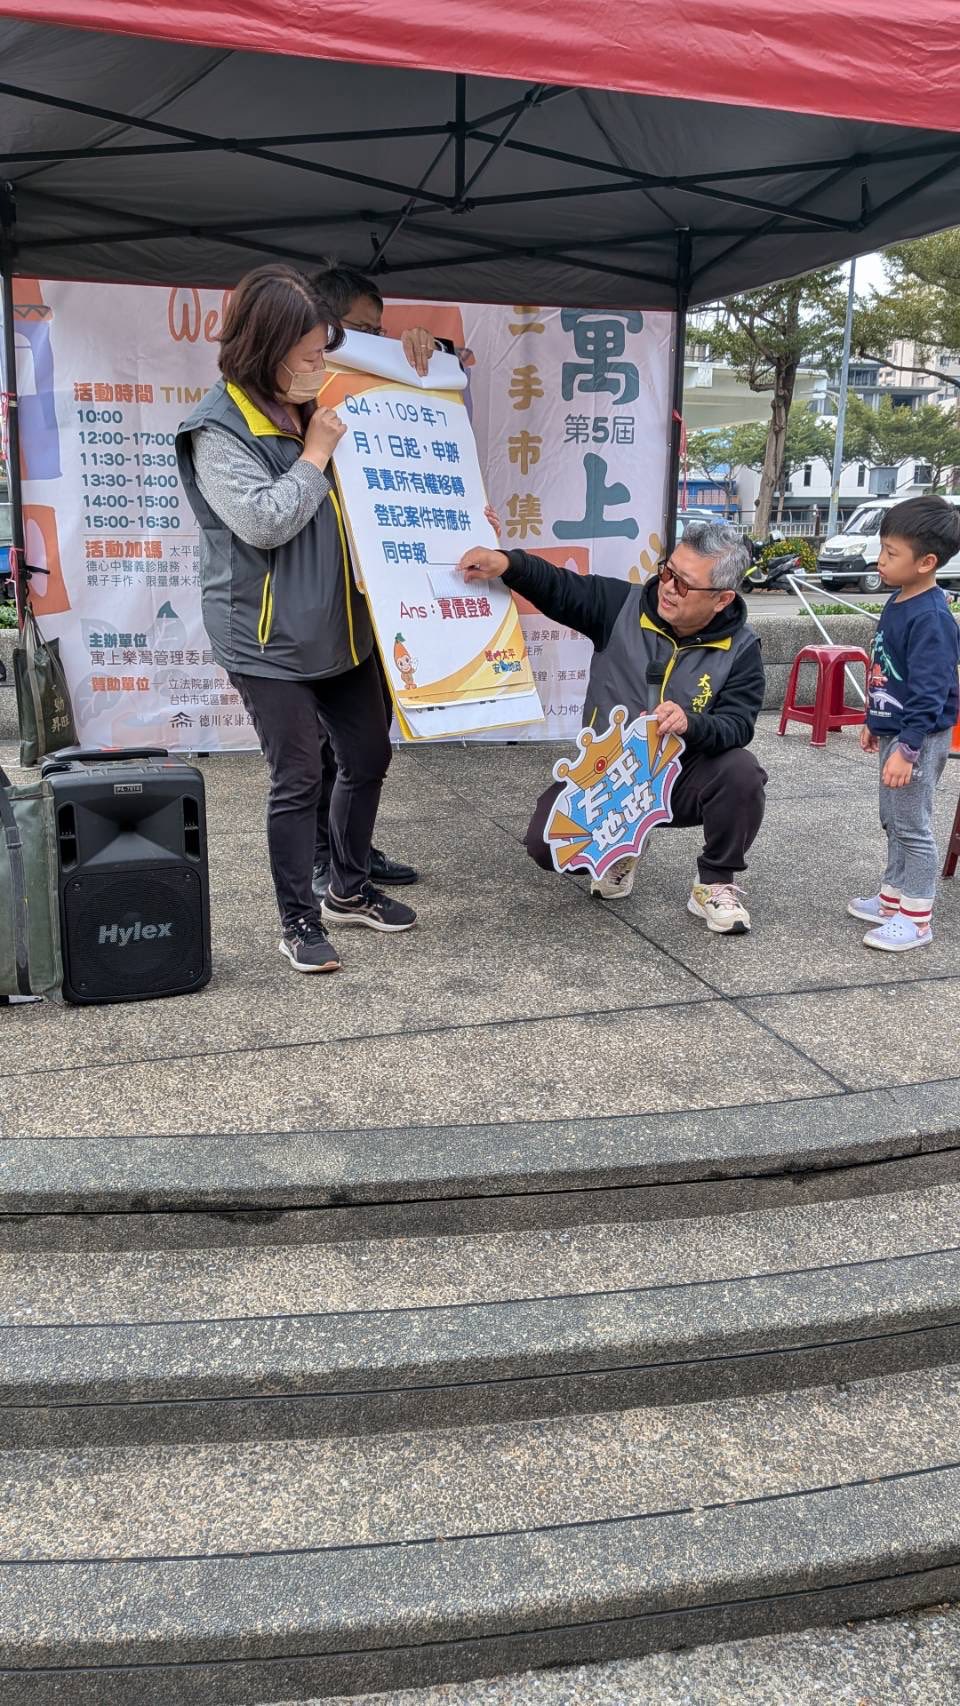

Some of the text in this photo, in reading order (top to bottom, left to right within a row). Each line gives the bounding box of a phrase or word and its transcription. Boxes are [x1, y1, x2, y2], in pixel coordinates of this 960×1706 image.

[74, 383, 211, 403] 活動時間 TIM
[77, 409, 123, 424] 10:00
[563, 414, 635, 444] 第5屆
[79, 431, 176, 446] 12:00-17:00
[80, 452, 177, 467] 11:30-13:30
[82, 474, 178, 488] 13:30-14:00
[362, 466, 466, 497] 買賣所有權移轉
[83, 495, 179, 508] 14:00-15:00
[552, 452, 639, 540] 上
[85, 515, 180, 529] 15:00-16:30
[85, 540, 163, 559] 活動加碼
[89, 633, 148, 648] 主辦單位
[91, 677, 150, 692] 贊助單位
[99, 921, 172, 947] Hylex
